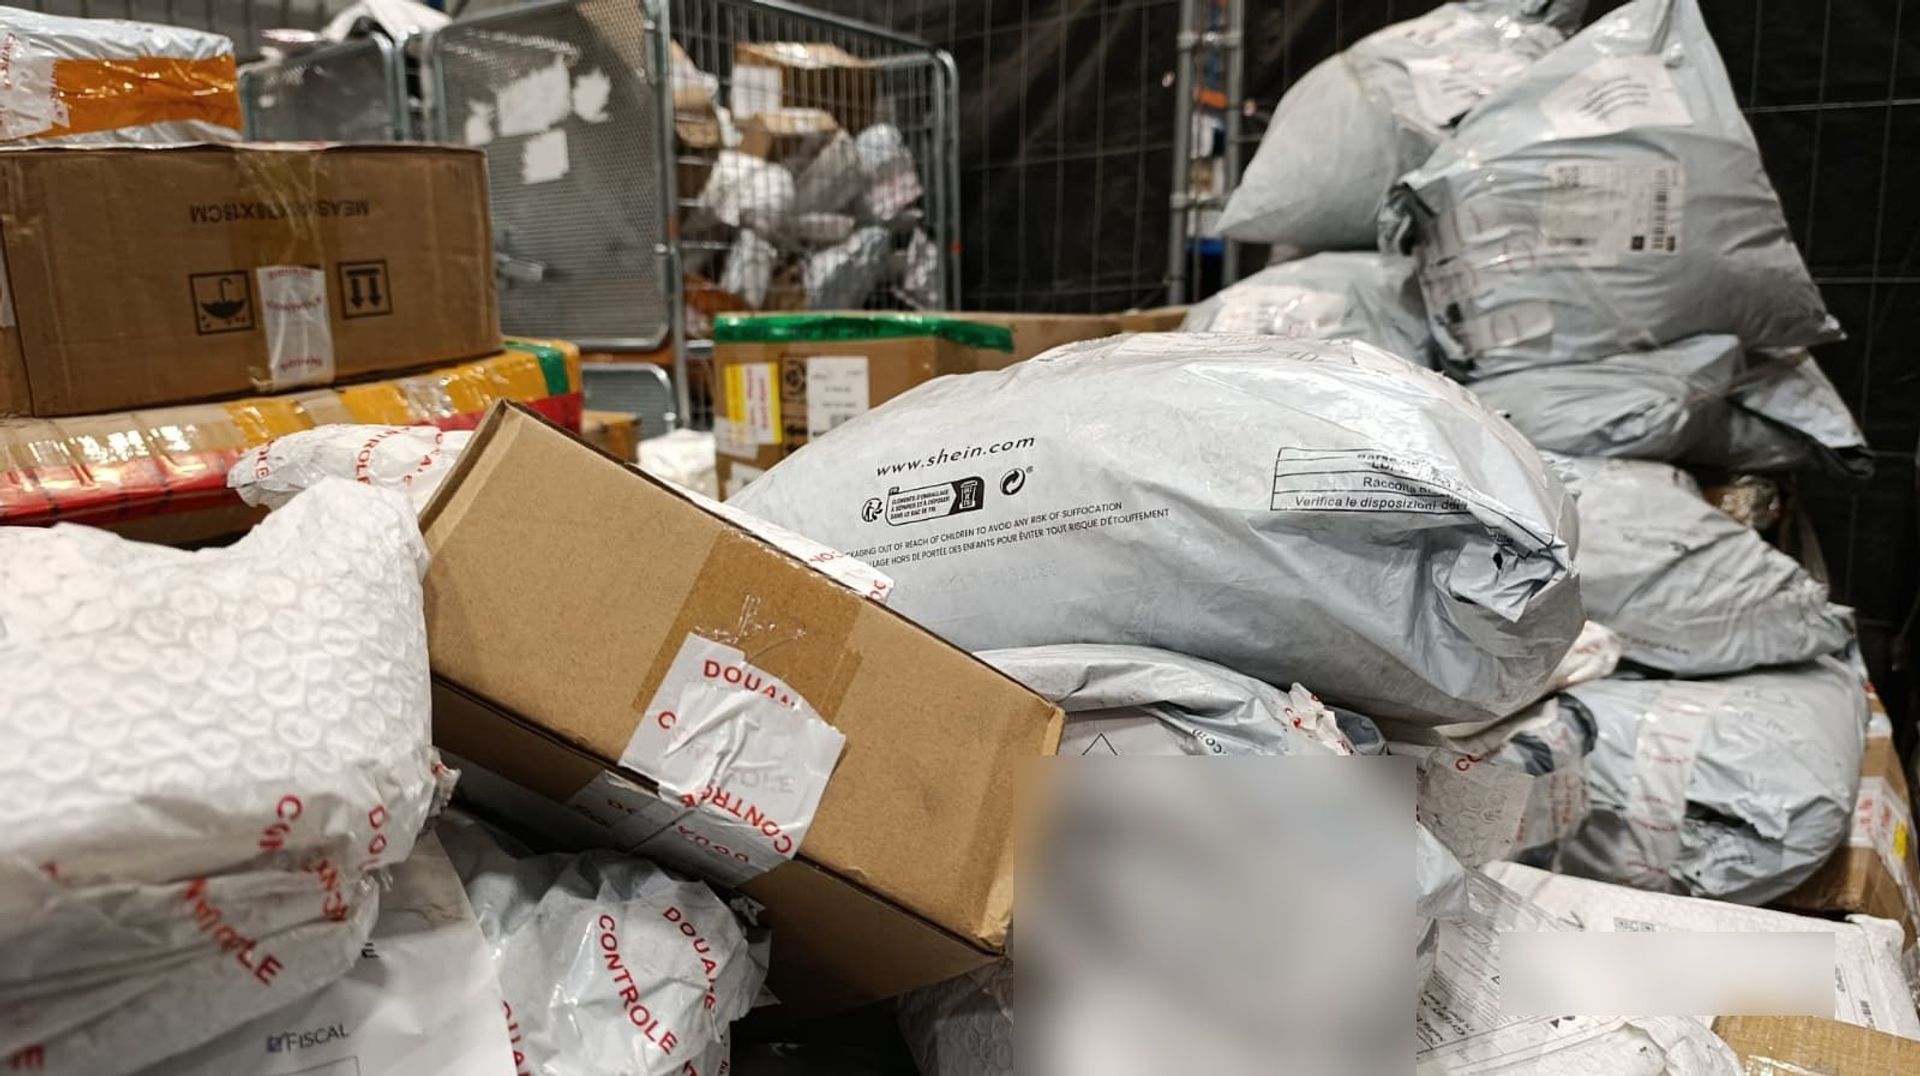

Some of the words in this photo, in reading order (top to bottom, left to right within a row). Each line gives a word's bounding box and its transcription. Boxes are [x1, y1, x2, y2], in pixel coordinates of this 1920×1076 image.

[876, 436, 1035, 477] www.shein.com
[1294, 495, 1342, 507] Verifica
[1345, 495, 1358, 508] le
[1360, 495, 1437, 510] disposizioni
[869, 556, 889, 568] LAGE
[891, 554, 911, 565] HORS
[912, 552, 921, 561] DE
[949, 545, 962, 555] DES
[963, 538, 995, 551] ENFANTS
[996, 534, 1017, 545] POUR
[1046, 525, 1067, 536] TOUT
[1068, 518, 1098, 532] RISQUE
[878, 544, 893, 555] OUT
[894, 542, 903, 551] OF
[904, 538, 928, 549] REACH
[930, 535, 939, 544] OF
[940, 529, 975, 543] CHILDREN
[976, 526, 987, 535] TO
[988, 520, 1011, 533] AVOID
[1014, 518, 1029, 528] ANY
[1031, 514, 1047, 524] RISK
[1050, 512, 1060, 521] OF
[1062, 501, 1122, 518] SUFFOCATION
[598, 913, 679, 1055] CONTROLE
[286, 1022, 350, 1051] FISCAL
